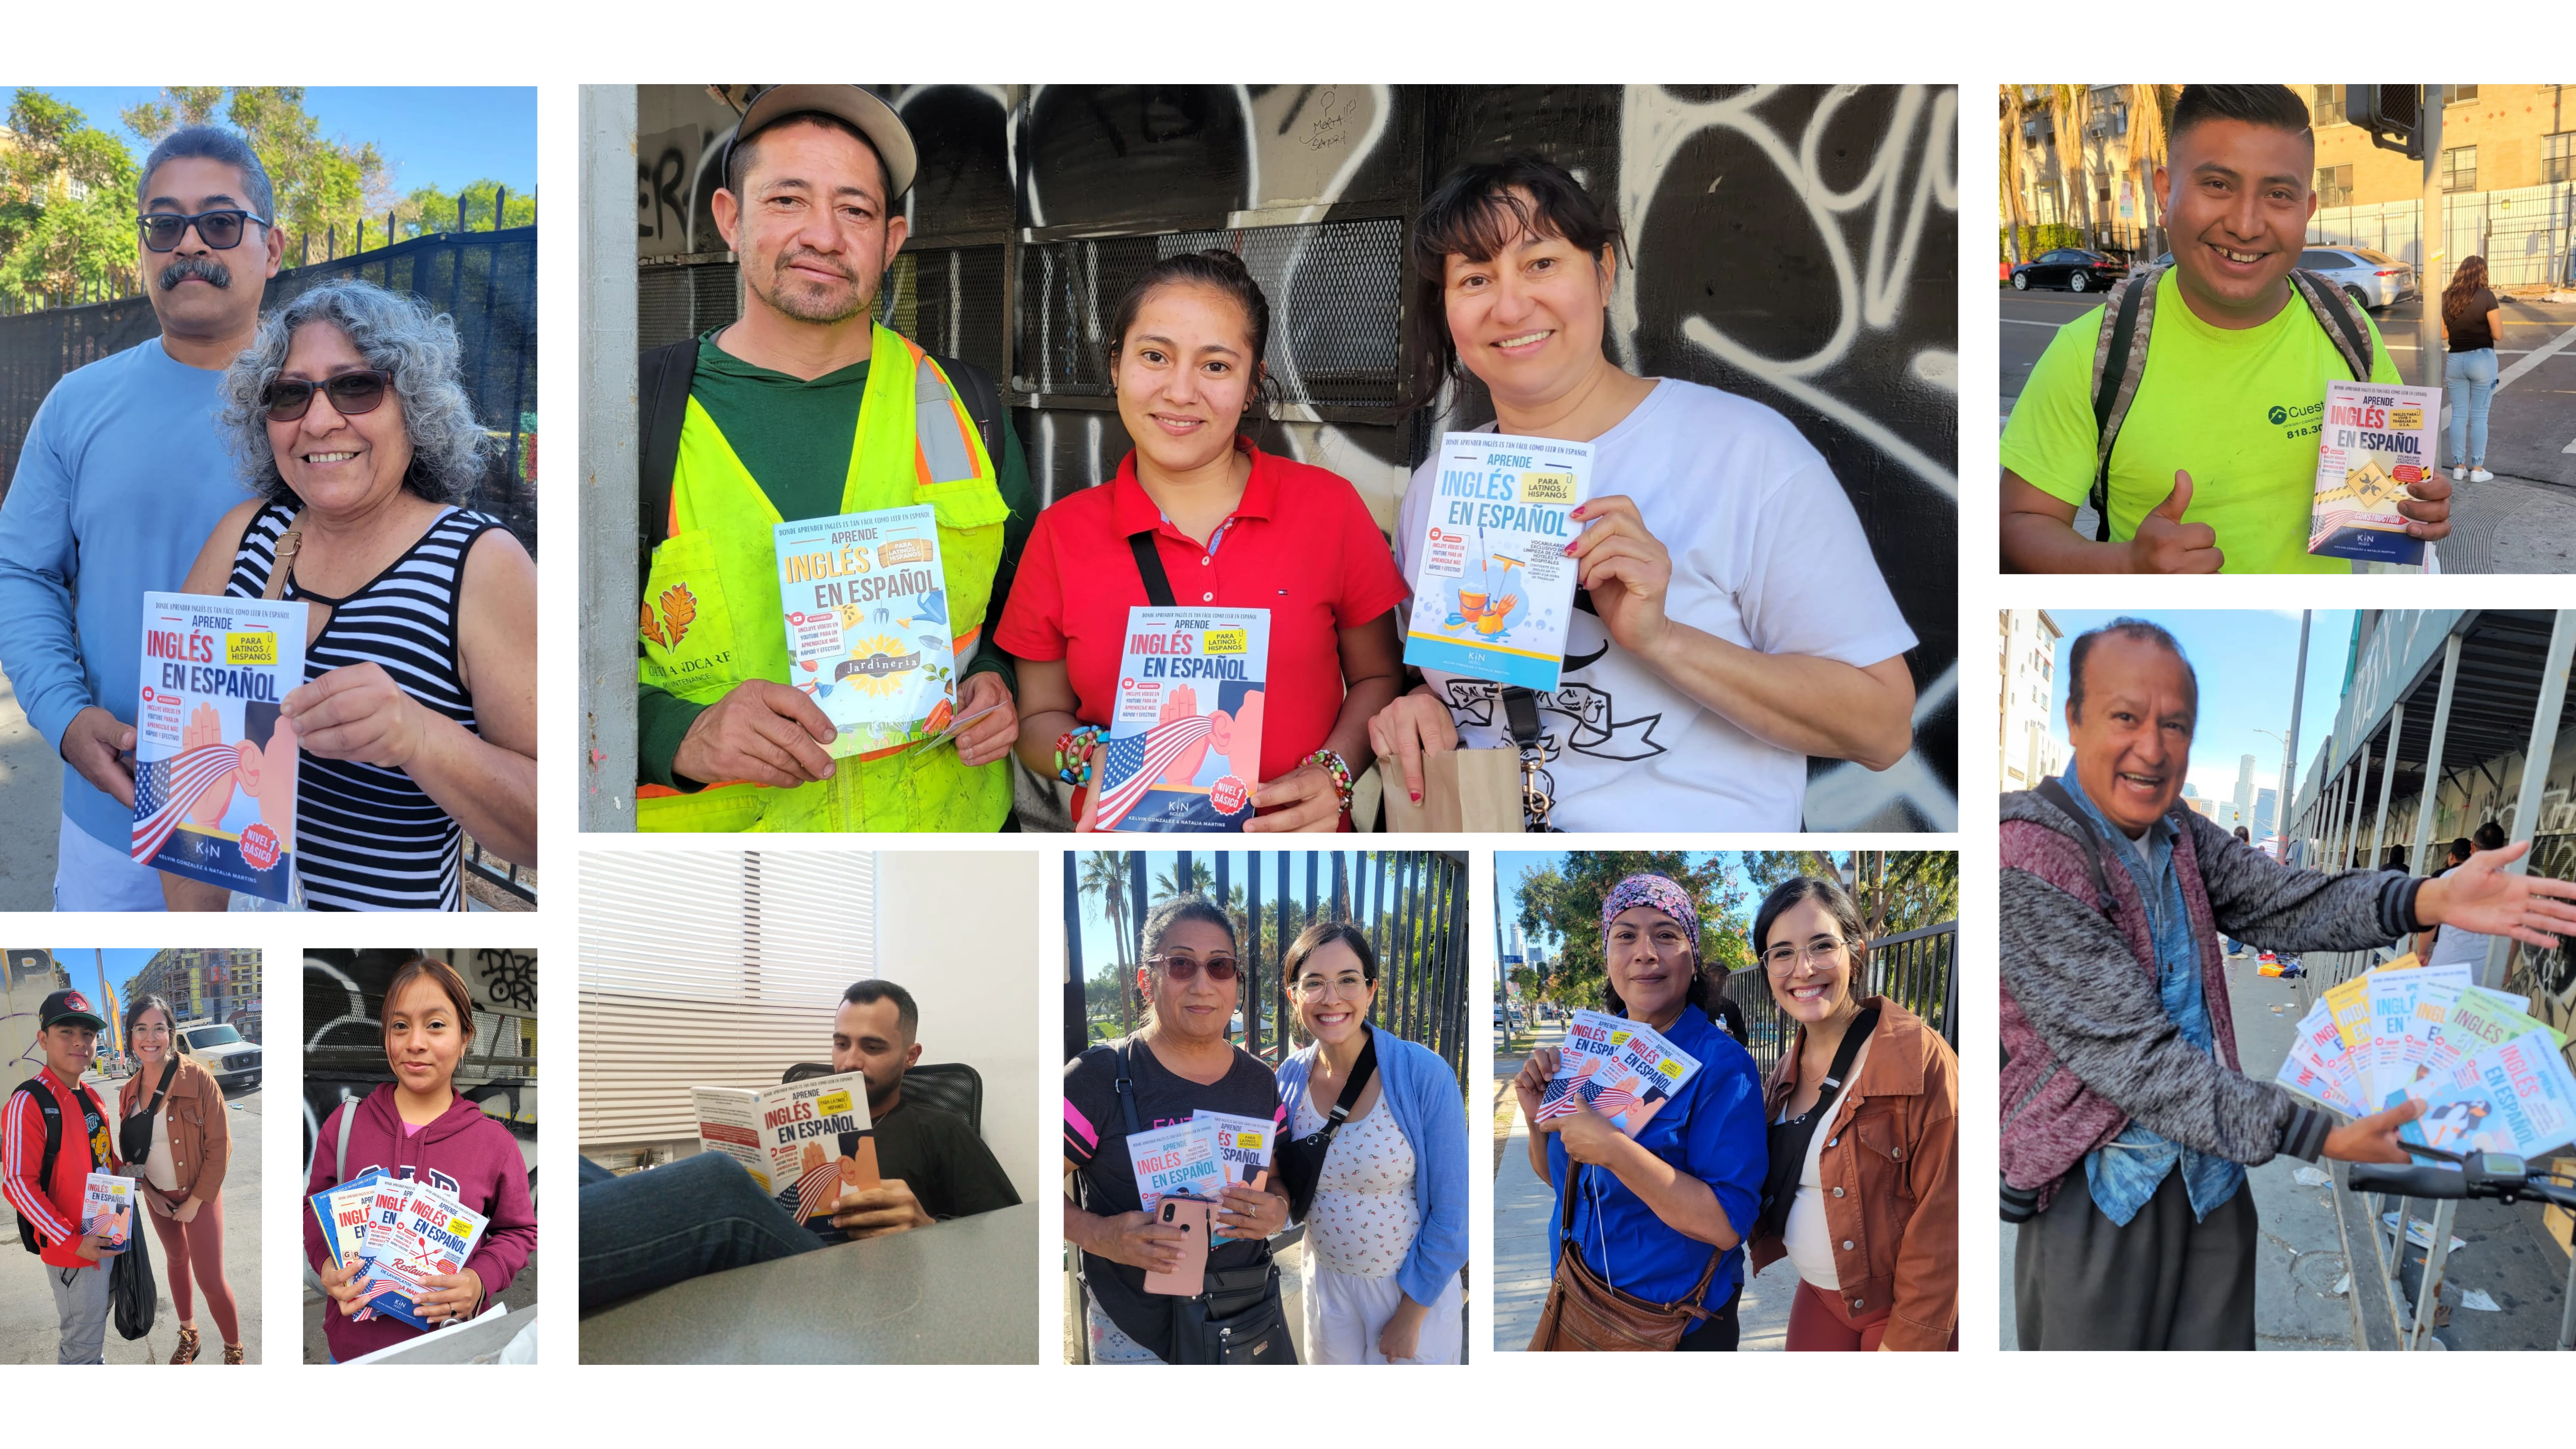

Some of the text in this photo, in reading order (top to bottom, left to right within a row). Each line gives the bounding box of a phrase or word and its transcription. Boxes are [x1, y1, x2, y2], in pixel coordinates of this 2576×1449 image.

[2363, 396, 2394, 406] APRENDE
[2330, 405, 2385, 429] INGLÉS
[1516, 442, 1528, 450] FÁCIL
[1565, 447, 1588, 457] ESPAÑOL
[2337, 429, 2421, 455] EN ESPAÑOL
[1487, 454, 1532, 468] APRENDE
[1441, 468, 1515, 501] INGLÉS
[798, 524, 823, 533] APRENDER
[824, 520, 841, 530] INGLÉS
[910, 511, 930, 519] ESPAÑOL
[1449, 501, 1568, 537] EN ESPAÑOL
[2354, 512, 2400, 524] CONSTRUCTION
[831, 527, 878, 545] APRENDE
[889, 546, 915, 556] LATINOS
[890, 551, 921, 561] HISPANOS
[784, 543, 871, 584] INGLÉS
[815, 567, 939, 609] EN ESPAÑOL
[223, 606, 234, 615] FÁCIL
[270, 610, 289, 619] ESPAÑOL
[192, 615, 233, 630] APRENDE
[1175, 620, 1210, 629] APRENDE
[147, 629, 213, 663] INGLÉS
[1130, 630, 1194, 655] INGLÉS
[847, 657, 918, 675] Jardinería
[1143, 655, 1249, 681] EN ESPAÑOL
[162, 662, 279, 702] EN ESPAÑOL
[148, 713, 163, 721] YOUTUBE
[1217, 782, 1244, 799] NIVEL 1
[1214, 792, 1239, 808] BÁSICO
[246, 829, 277, 853] NIVEL 1
[244, 842, 271, 863] BÁSICO
[158, 854, 257, 883] KELVIN GONZALEZ NATALIA MARTINS
[1571, 1024, 1607, 1042] INGLÉS
[1598, 1021, 1619, 1030] APRENDE
[2386, 1017, 2404, 1033] EN
[2454, 1008, 2504, 1044] INGLÉS
[1575, 1038, 1589, 1052] EN
[1627, 1037, 1660, 1064] INGLÉS
[1656, 1044, 1673, 1058] APRENDE
[1624, 1052, 1671, 1092] EN ESPAÑOL
[1661, 1066, 1677, 1077] HISPANOS
[1662, 1063, 1675, 1073] LATINOS
[2499, 1044, 2539, 1098] INGLÉS
[793, 1088, 820, 1100] APRENDE
[765, 1100, 812, 1130] INGLÉS
[2485, 1066, 2535, 1150] EN ESPAÑOL
[778, 1125, 796, 1144] EN
[798, 1114, 858, 1138] ESPAÑOL
[1221, 1123, 1242, 1132] APRENDE
[1163, 1140, 1188, 1152] APRENDE
[1137, 1150, 1181, 1175] INGLÉS
[1152, 1161, 1218, 1189] EN ESPAÑOL
[88, 1184, 109, 1193] INGLÉS
[101, 1194, 126, 1204] ESPAÑOL
[382, 1210, 397, 1225] EN
[410, 1199, 447, 1227] INGLÉS
[439, 1202, 459, 1216] APRENDE
[413, 1218, 466, 1255] EN ESPAÑOL
[443, 1255, 459, 1264] RESTAURANTES
[447, 1251, 461, 1260] VOCABULARIO
[386, 1272, 414, 1288] LAVAPLATOS...
